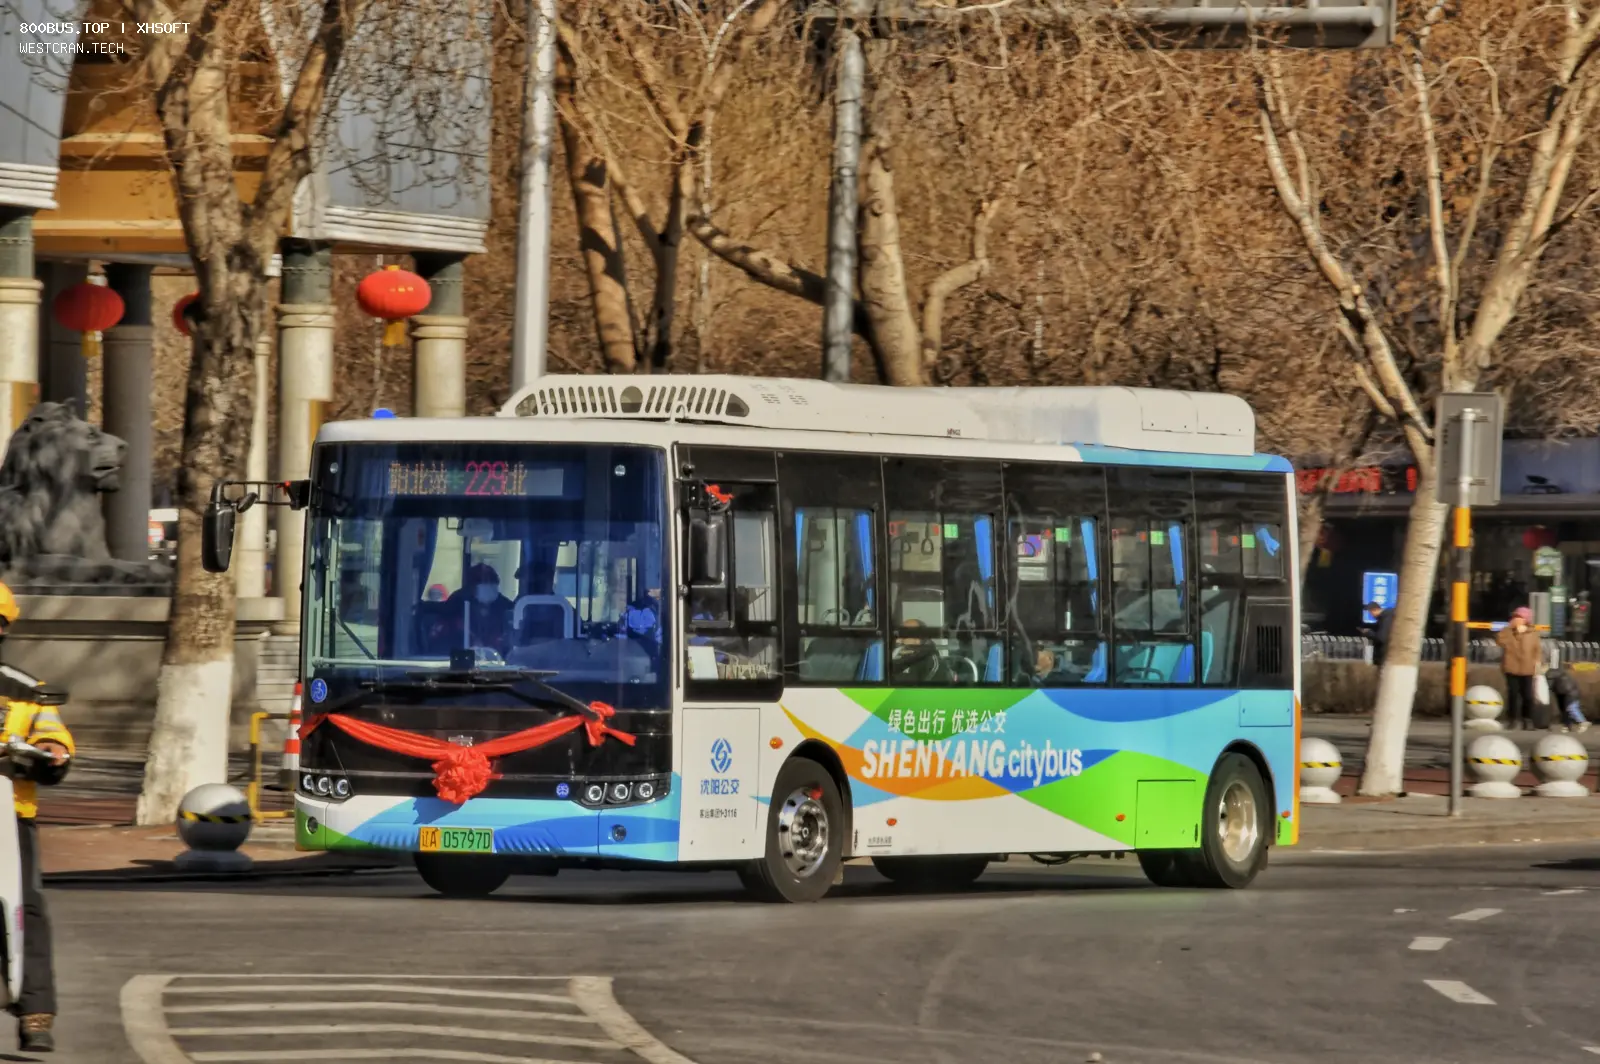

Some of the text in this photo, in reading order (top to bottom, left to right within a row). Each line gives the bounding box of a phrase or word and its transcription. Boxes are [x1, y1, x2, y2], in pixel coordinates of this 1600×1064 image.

[464, 461, 505, 495] 229
[888, 709, 1007, 735] 绿色出行 优选公交
[860, 739, 1083, 787] SHENYANG citybus
[700, 778, 740, 795] 沈阳公交
[422, 831, 491, 849] 辽A 05797D
